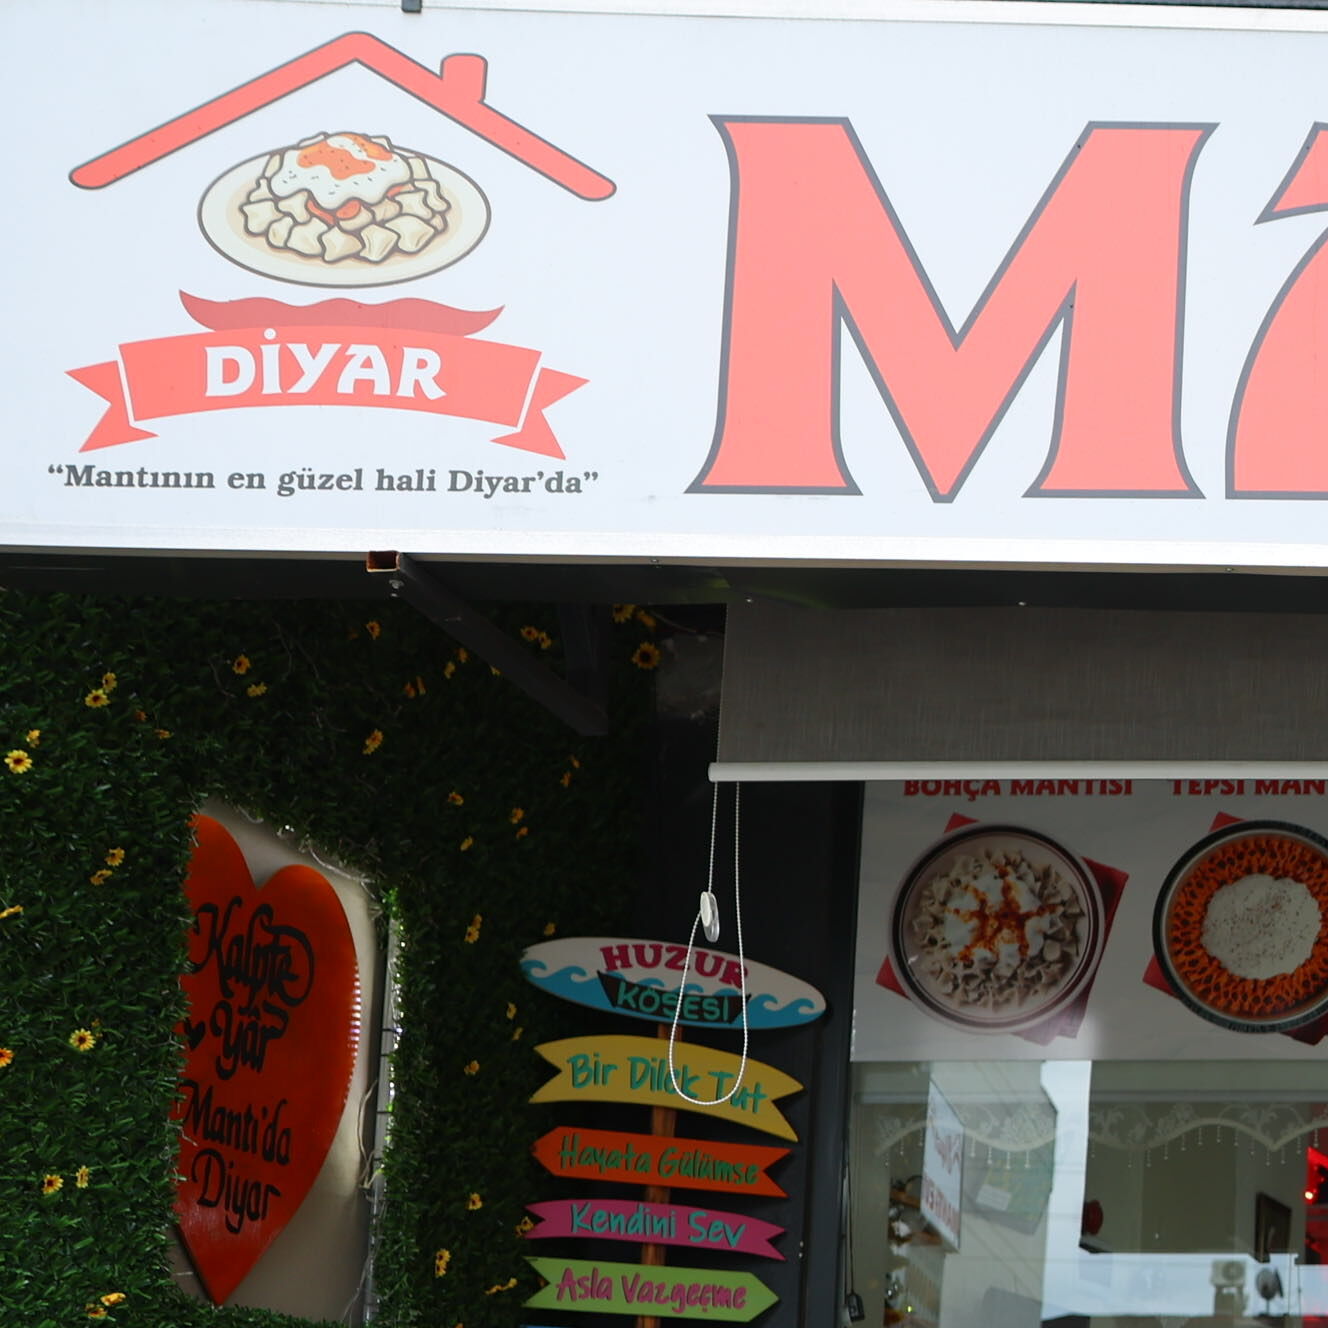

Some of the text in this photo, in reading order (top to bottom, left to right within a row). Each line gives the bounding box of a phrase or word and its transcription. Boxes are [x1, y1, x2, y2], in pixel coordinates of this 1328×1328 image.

[205, 328, 447, 401] DİYAR
[227, 472, 266, 491] en
[277, 467, 363, 495] güzel
[375, 468, 436, 493] hali
[904, 779, 1132, 801] BOHÇA MANTISI
[600, 943, 750, 989] HUZUR
[567, 1053, 768, 1114] Bir Dilek Tut
[560, 1134, 760, 1185] Hayata Gülümse
[191, 1148, 281, 1235] Diyar
[571, 1202, 747, 1248] Kendini Sev
[556, 1267, 748, 1313] Asla Vazgeçme
